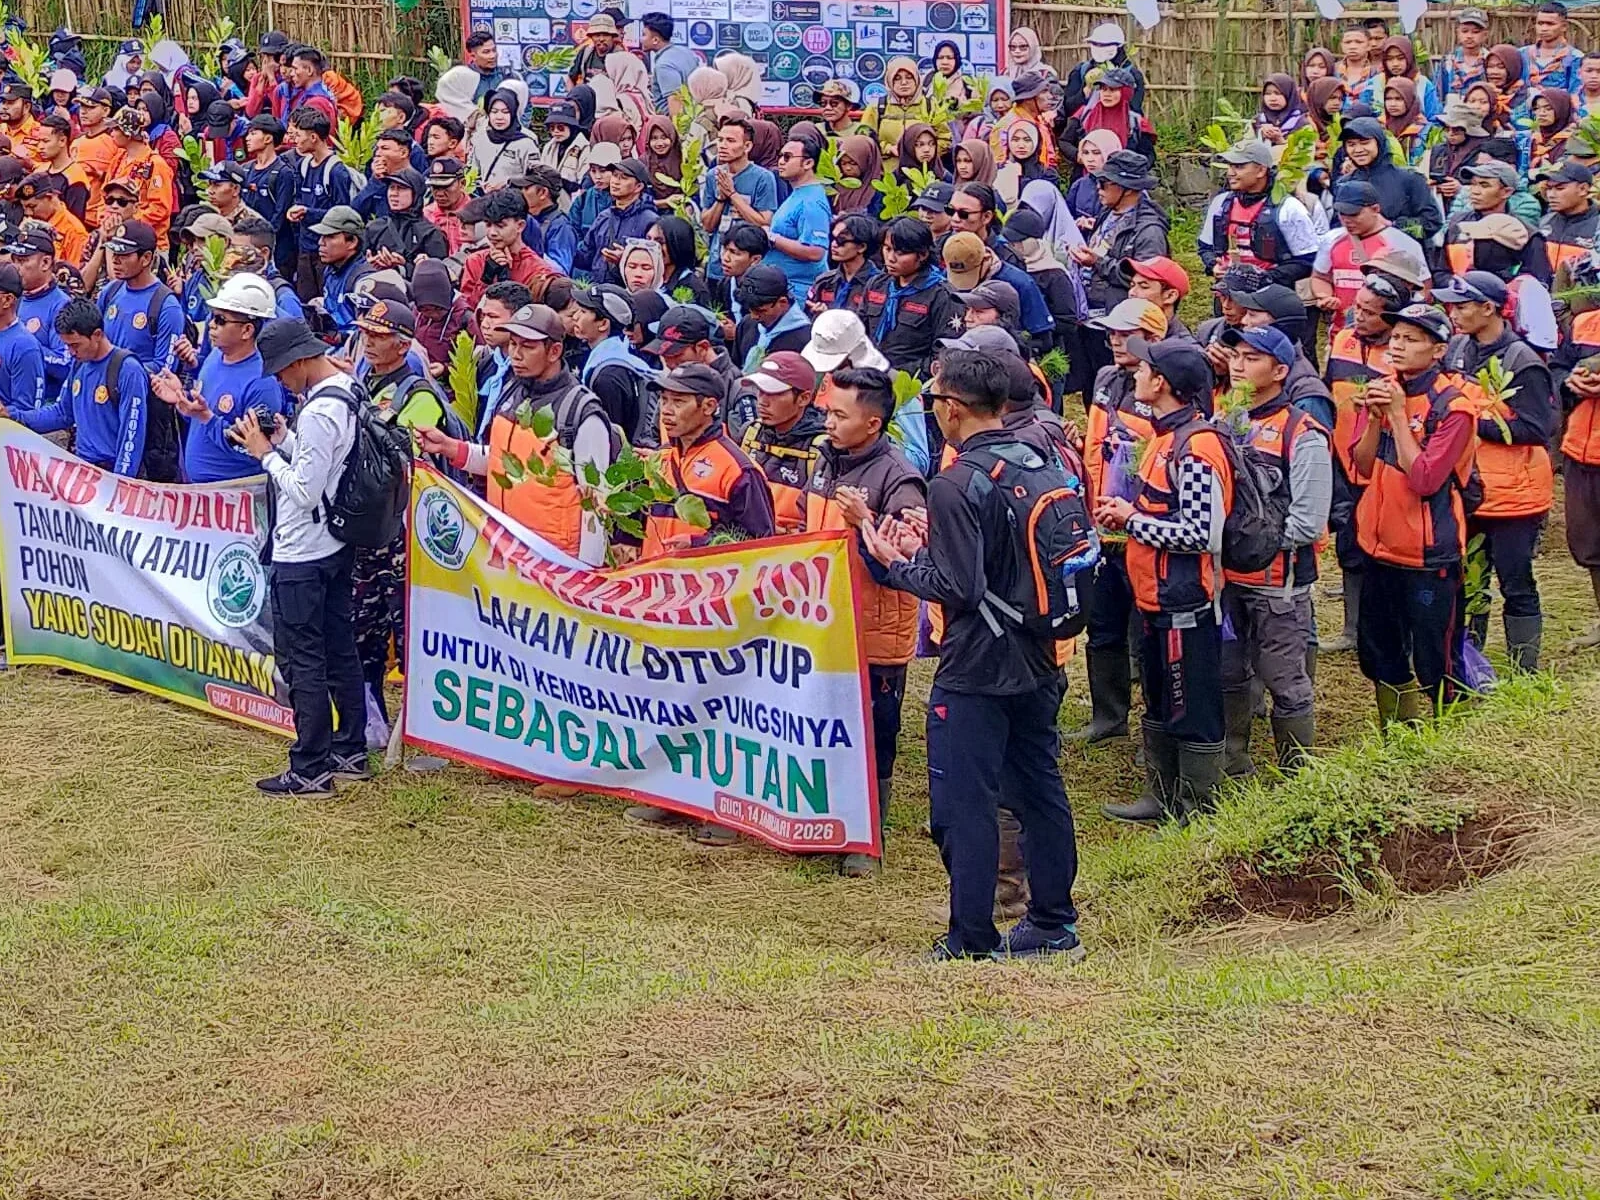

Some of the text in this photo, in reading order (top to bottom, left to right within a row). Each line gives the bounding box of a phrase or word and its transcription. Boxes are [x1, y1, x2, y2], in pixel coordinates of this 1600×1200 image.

[119, 396, 142, 475] PROVOST
[4, 445, 255, 536] WAJIB MENJAGA
[19, 545, 90, 594] POHON
[140, 535, 210, 582] ATAU
[21, 588, 90, 639] YANG
[90, 601, 166, 661] SUDAH
[167, 624, 276, 697] DITANAM
[473, 586, 812, 689] LAHAN INI DITUTUP
[236, 697, 246, 712] 14
[247, 699, 283, 724] JANUARI
[422, 629, 853, 748] UNTUK DI KEMBALIKAN PUNGSINYA
[1171, 663, 1184, 706] SPORT
[432, 668, 830, 814] SEBAGAI HUTAN
[719, 796, 834, 840] GUCI, 14 JANUARI 2026
